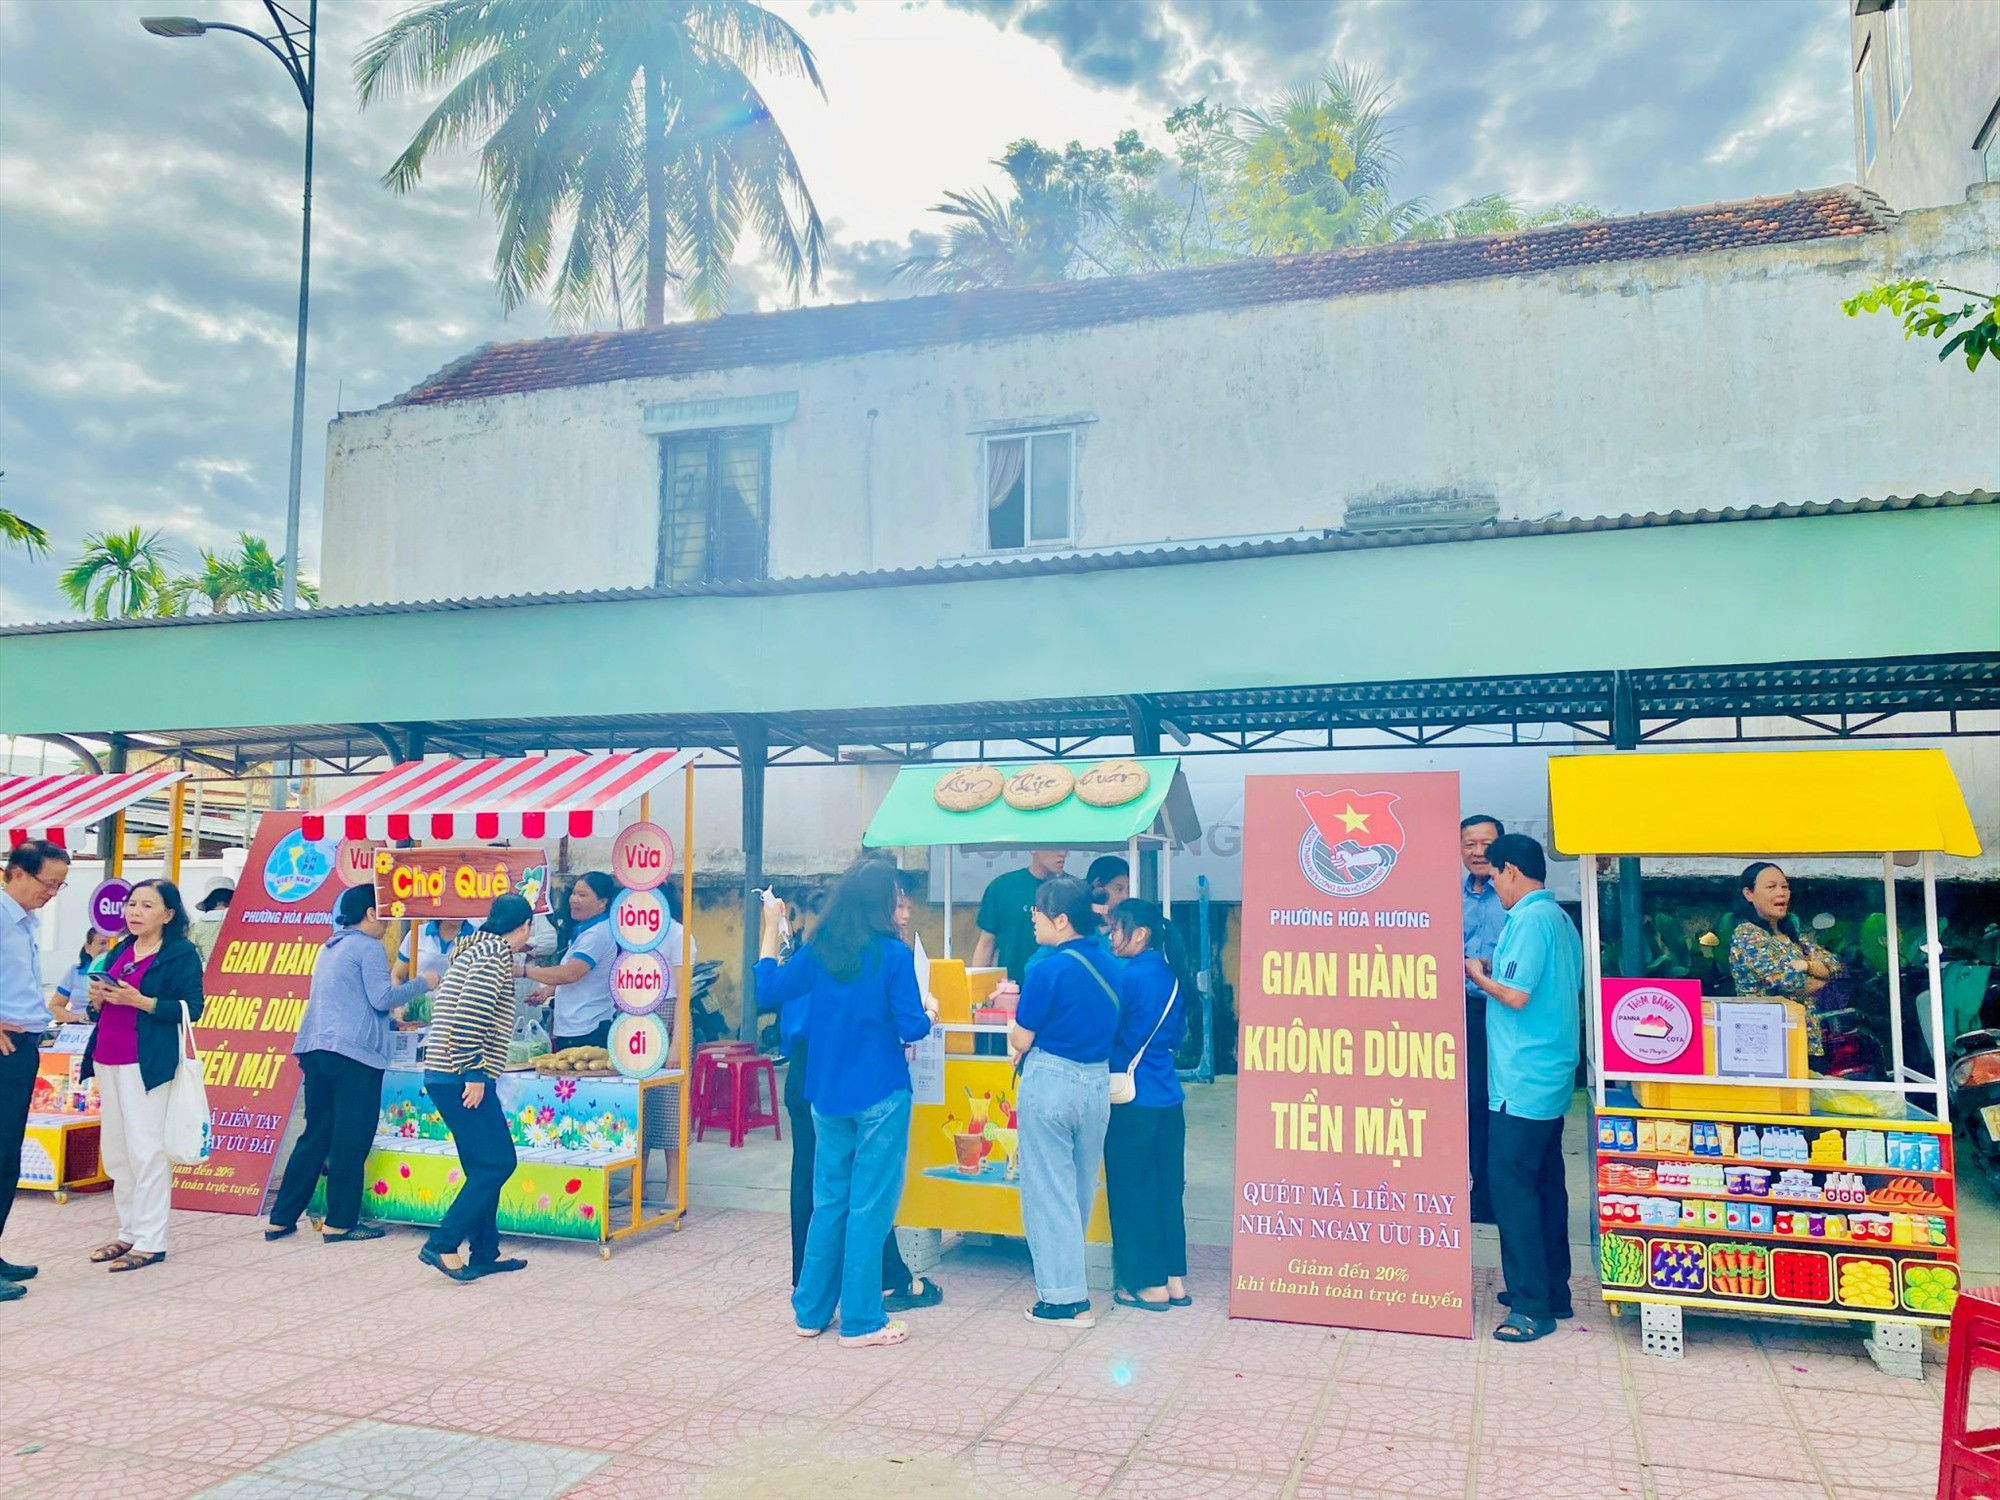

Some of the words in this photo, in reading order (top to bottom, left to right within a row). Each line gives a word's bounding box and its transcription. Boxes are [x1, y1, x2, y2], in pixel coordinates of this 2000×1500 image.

[350, 847, 374, 870] Vui
[624, 842, 661, 869] Vừa
[392, 865, 446, 906] Chợ
[455, 862, 510, 898] Quê
[241, 908, 282, 923] PHƯỜNG
[281, 909, 302, 924] HÒA
[619, 904, 660, 931] lòng
[1270, 906, 1333, 926] PHƯỜNG
[1338, 907, 1370, 927] HÒA
[1375, 911, 1429, 928] HƯƠNG
[221, 941, 274, 974] GIAN
[617, 968, 661, 990] khách
[1262, 950, 1337, 996] GIAN
[1349, 944, 1438, 1000] HÀNG
[259, 991, 309, 1033] DÙN
[1652, 995, 1675, 1012] BÁNH
[628, 1030, 647, 1055] đi
[1244, 1017, 1353, 1075] KHÔNG
[1364, 1021, 1456, 1080] DÙNG
[234, 1046, 286, 1096] MẶT
[218, 1106, 254, 1128] LIỀN
[255, 1114, 282, 1130] TAY
[1271, 1088, 1343, 1153] TIỀN
[1355, 1097, 1427, 1167] MẶT
[226, 1135, 248, 1151] ƯU
[248, 1134, 276, 1154] ĐÃI
[193, 1162, 212, 1176] đến
[214, 1166, 235, 1178] 20%
[180, 1178, 203, 1190] toán
[206, 1180, 229, 1195] trực
[230, 1183, 260, 1197] tuyến
[1243, 1179, 1305, 1205] QUÉT
[1311, 1182, 1345, 1209] MÃ
[1351, 1181, 1407, 1212] LIỀN
[1413, 1193, 1456, 1215] TAY
[1239, 1211, 1304, 1241] NHẬN
[1310, 1218, 1372, 1242] NGAY
[1378, 1221, 1412, 1245] ƯU
[1418, 1222, 1461, 1249] ĐÃI
[1288, 1258, 1333, 1277] Giảm
[1338, 1262, 1370, 1280] đến
[1374, 1266, 1410, 1283] 20%
[1236, 1275, 1264, 1291] khi
[1269, 1278, 1319, 1296] thanh
[1325, 1283, 1363, 1300] toán
[1369, 1288, 1406, 1307] trực
[1411, 1290, 1463, 1310] tuyến
